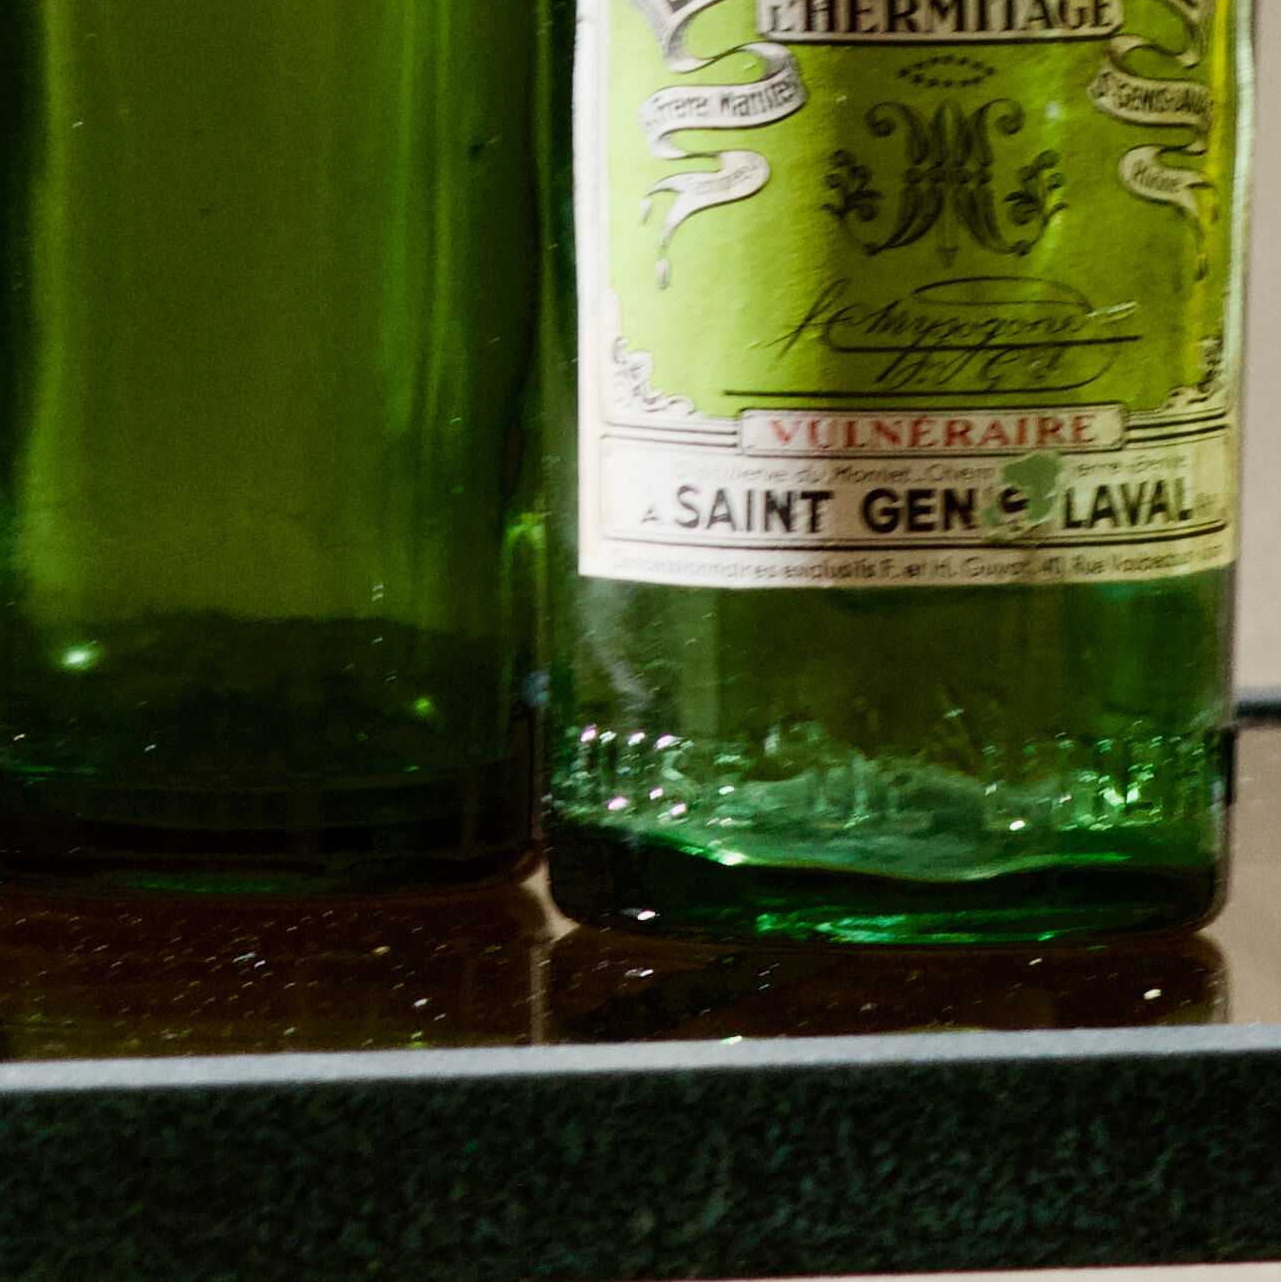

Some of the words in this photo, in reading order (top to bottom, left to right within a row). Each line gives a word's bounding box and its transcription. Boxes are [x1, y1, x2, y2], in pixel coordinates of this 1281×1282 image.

[768, 414, 1098, 449] VULNÉRAIRE
[675, 484, 835, 535] SAINT
[1064, 478, 1194, 530] LAVAL
